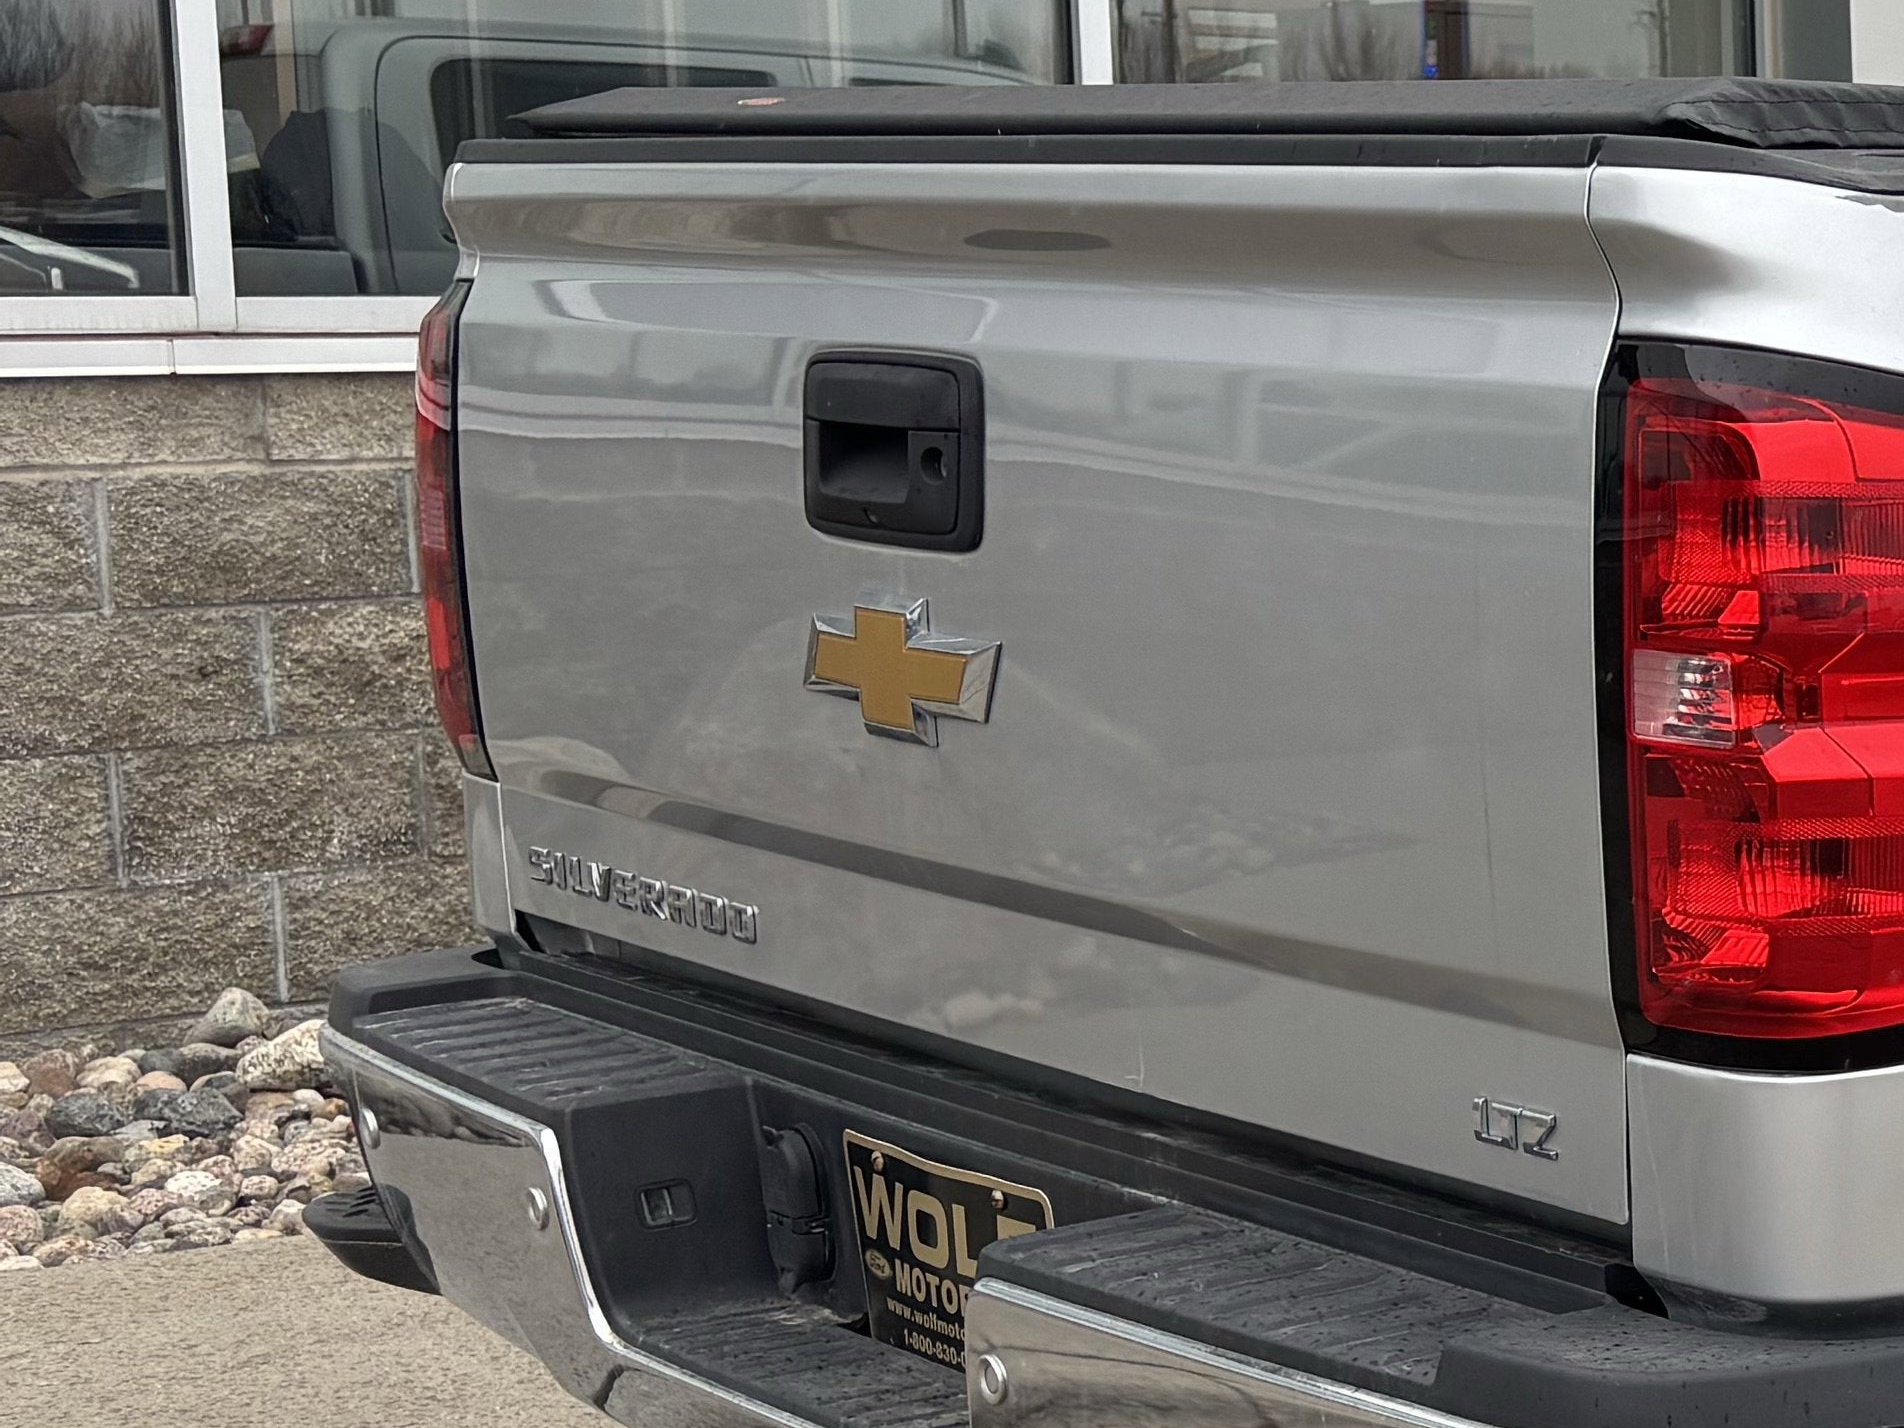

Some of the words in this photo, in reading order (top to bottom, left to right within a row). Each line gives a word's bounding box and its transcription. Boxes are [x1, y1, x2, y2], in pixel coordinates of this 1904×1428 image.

[528, 845, 760, 944] SILVERADO
[1471, 1095, 1560, 1162] LTZ
[852, 1165, 1037, 1280] WOL
